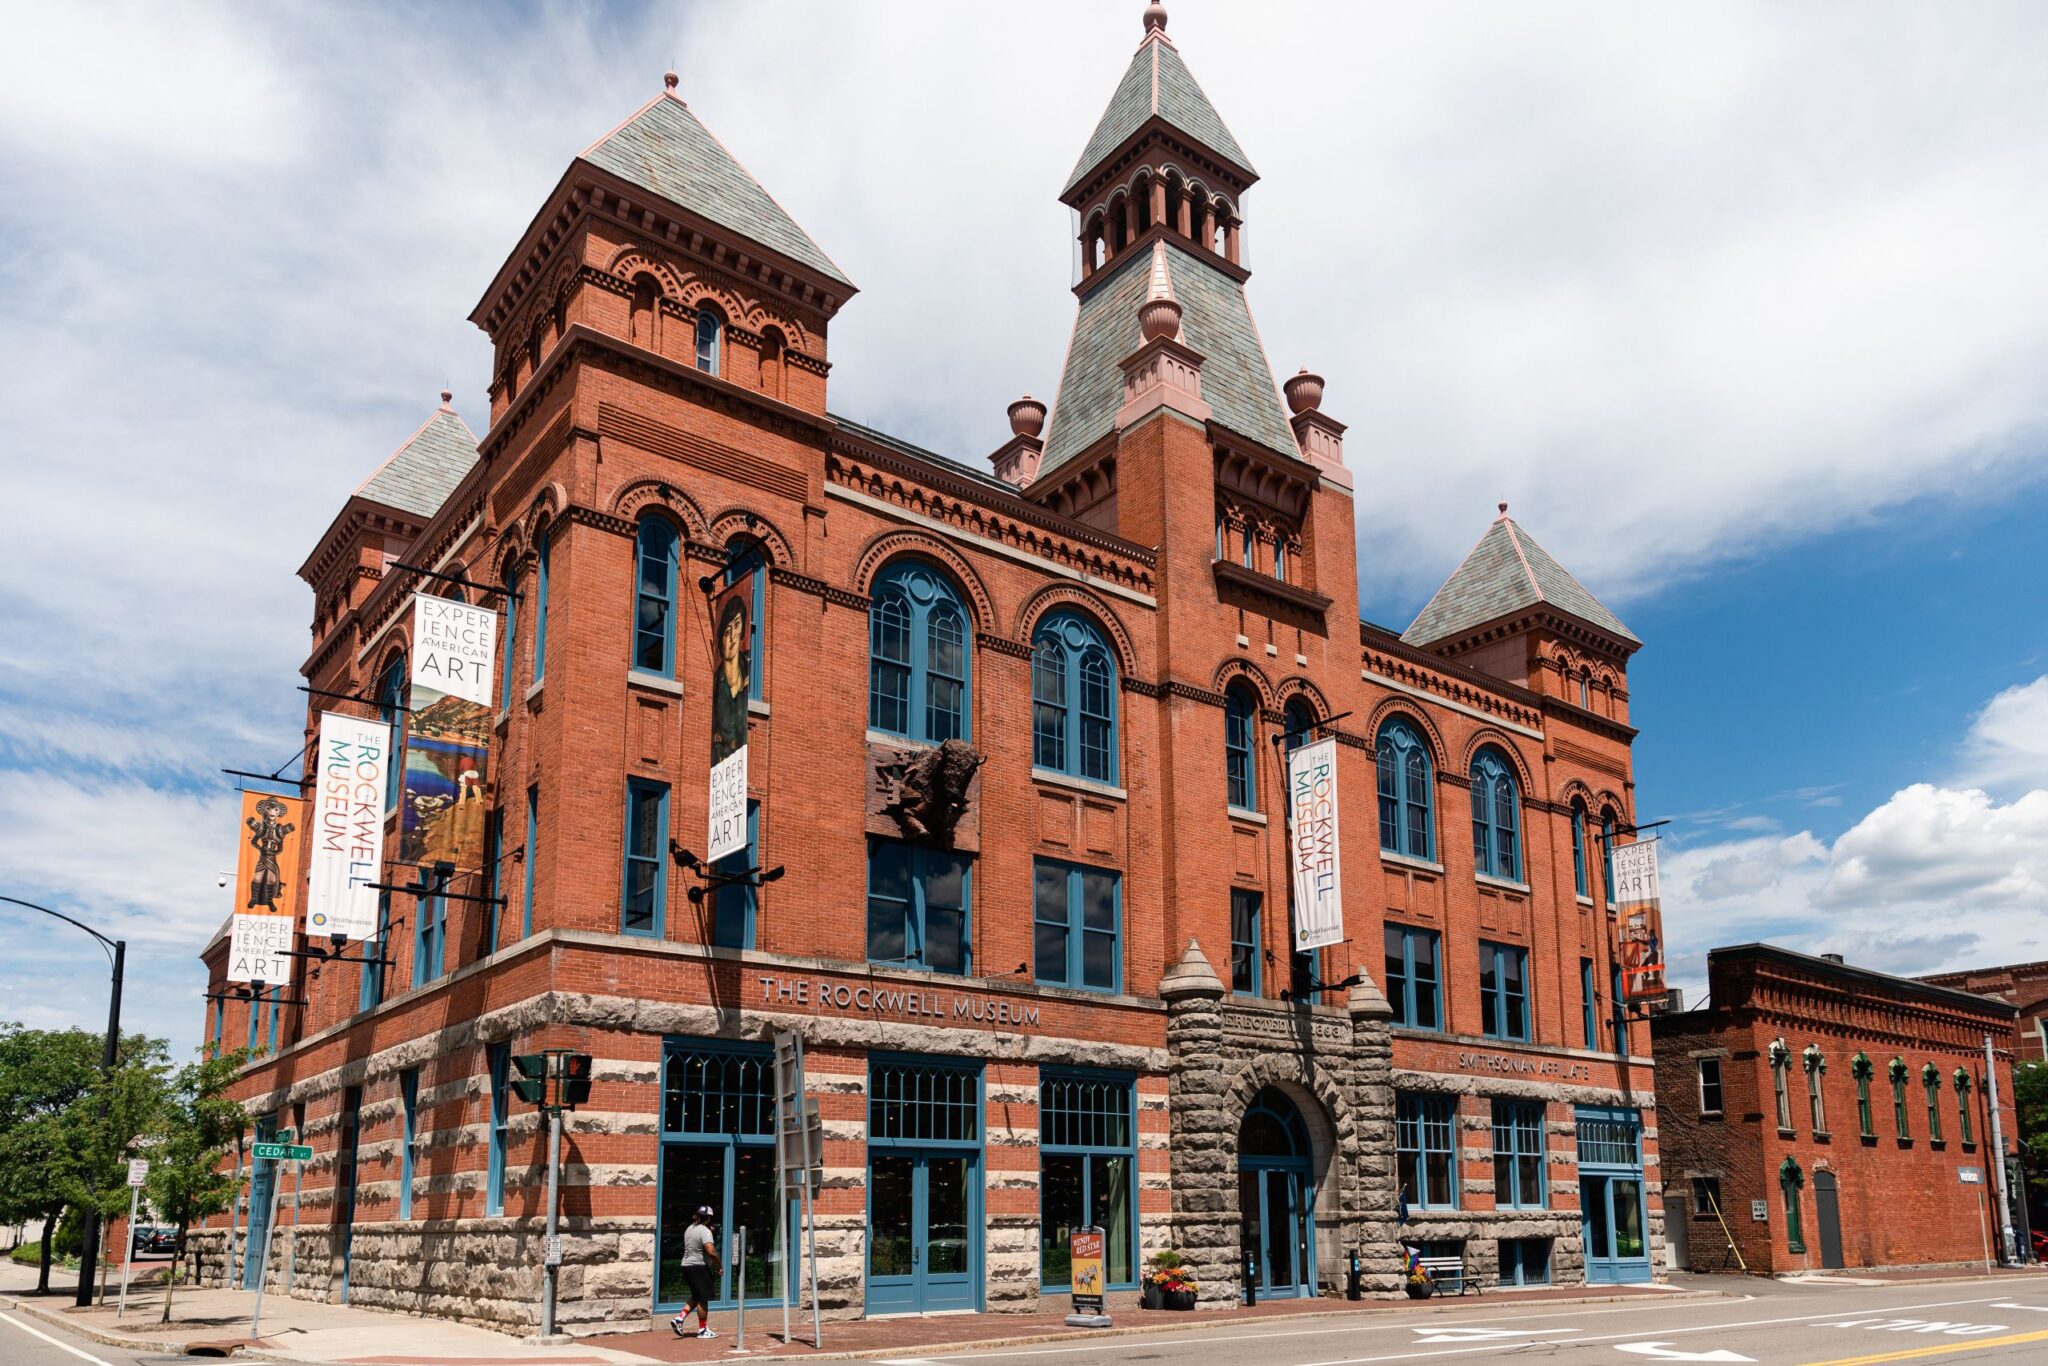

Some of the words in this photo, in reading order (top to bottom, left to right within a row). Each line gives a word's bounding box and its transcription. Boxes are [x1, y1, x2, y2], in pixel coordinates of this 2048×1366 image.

[424, 600, 489, 629] EXPER
[423, 619, 488, 648] IENCE
[421, 637, 488, 659] AMERICAN
[420, 652, 487, 684] ART
[357, 733, 381, 745] THE
[1312, 752, 1329, 764] THE
[712, 759, 744, 788] EXPER
[322, 739, 352, 852] MUSEUM
[711, 778, 743, 807] IENCE
[349, 745, 381, 889] ROCKWELL
[711, 800, 743, 820] AMERICAN
[711, 813, 742, 849] ART
[1295, 770, 1314, 873] MUSEUM
[1314, 763, 1334, 902] ROCKWELL
[1616, 844, 1652, 859] EXPER
[1616, 854, 1653, 871] IENCE
[1616, 866, 1654, 878] AMERICAN
[1619, 874, 1654, 894] ART
[238, 919, 288, 934] EXPER
[235, 946, 286, 958] AMERIC
[237, 933, 287, 949] IENCE
[234, 957, 285, 977] ART
[759, 977, 808, 1004] THE
[818, 982, 945, 1017] ROCKWELL
[953, 998, 1040, 1027] MUSEUM
[1224, 1014, 1287, 1036] ERECTED
[1459, 1052, 1536, 1074] SMITHSONIAN
[258, 1146, 294, 1157] CEDAR
